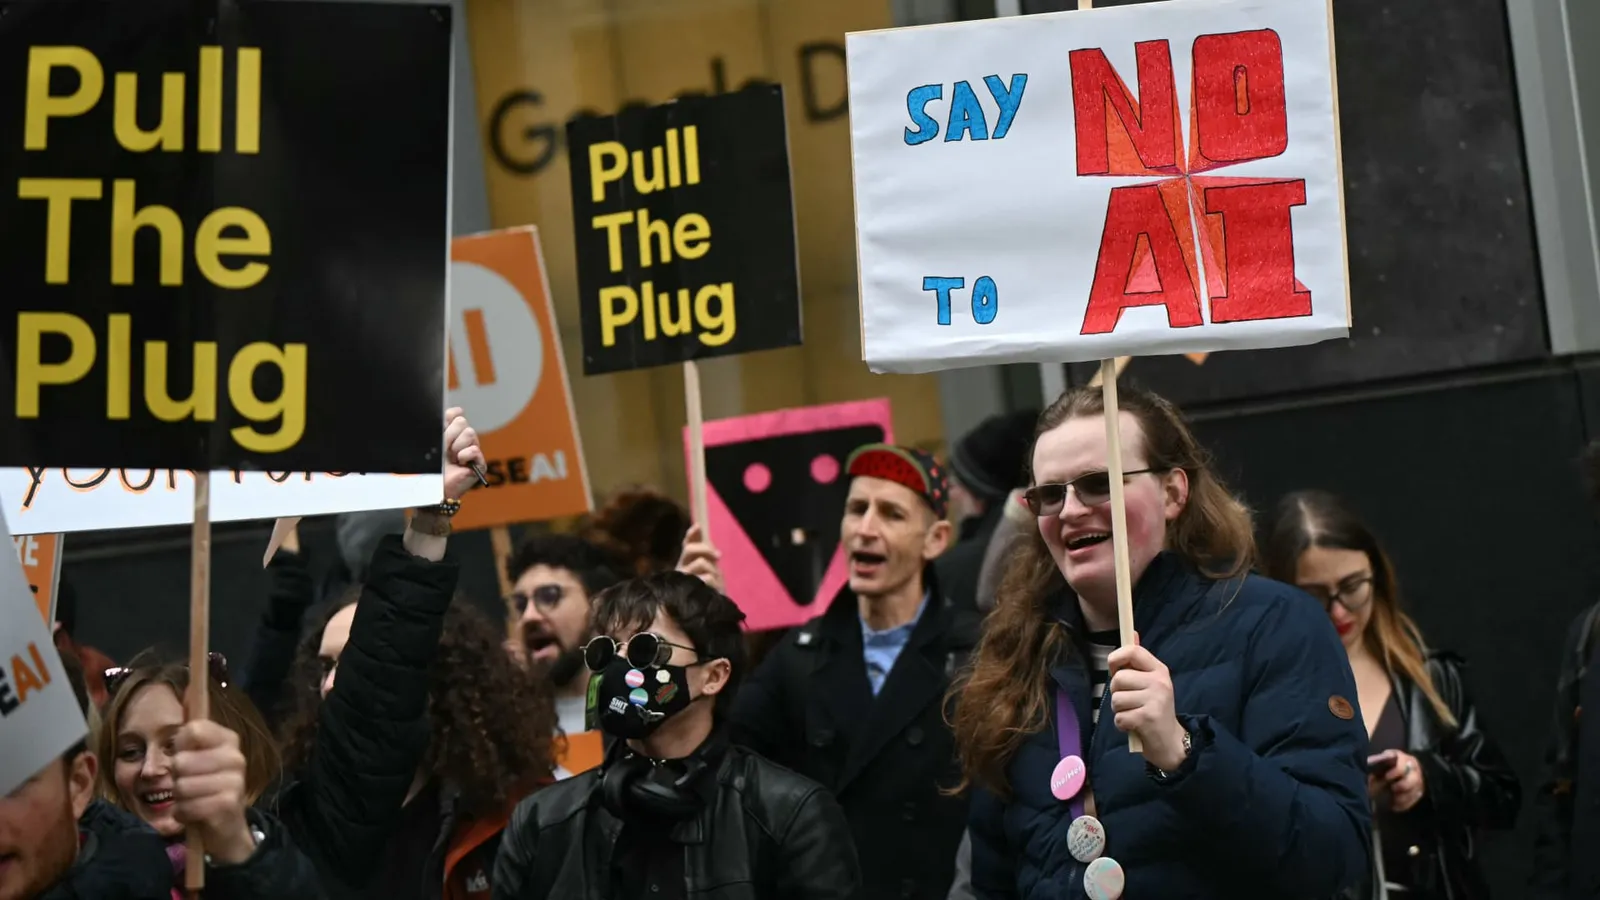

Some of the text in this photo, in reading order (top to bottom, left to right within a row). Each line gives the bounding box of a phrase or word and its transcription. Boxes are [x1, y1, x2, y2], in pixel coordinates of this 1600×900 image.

[24, 46, 261, 154] Pull
[904, 73, 1028, 146] SAY
[1069, 28, 1288, 177] NO
[588, 125, 700, 202] Pull
[18, 178, 271, 289] The
[592, 208, 711, 273] The
[922, 178, 1313, 336] TO AI
[598, 281, 737, 347] Plug
[16, 311, 307, 453] Plug
[474, 450, 567, 489] SEAI
